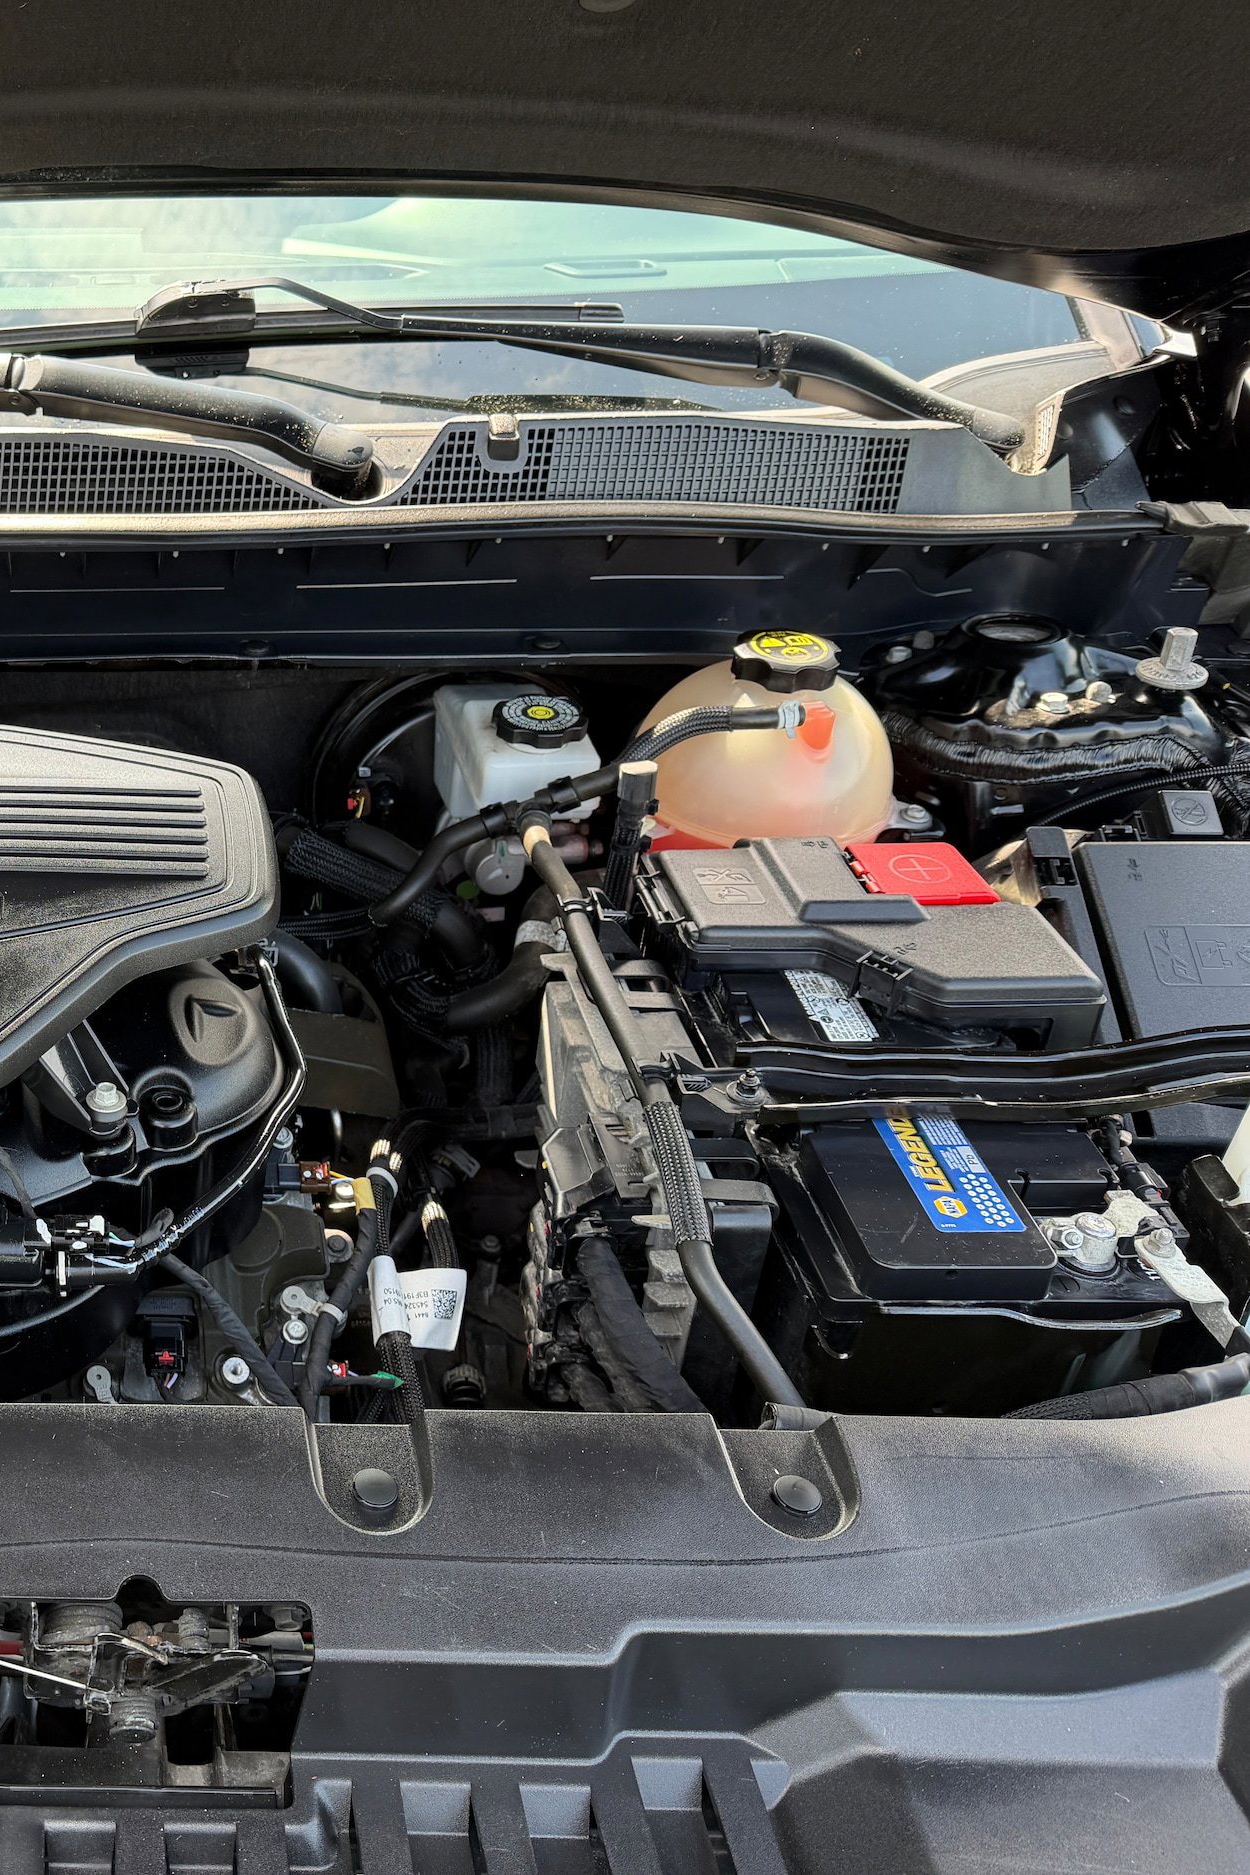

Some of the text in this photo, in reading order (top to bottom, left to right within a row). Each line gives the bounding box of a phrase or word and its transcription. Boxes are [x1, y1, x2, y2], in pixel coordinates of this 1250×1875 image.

[886, 1117, 956, 1193] LEGEND
[967, 1154, 979, 1165] Pb
[941, 1199, 961, 1214] NAPA
